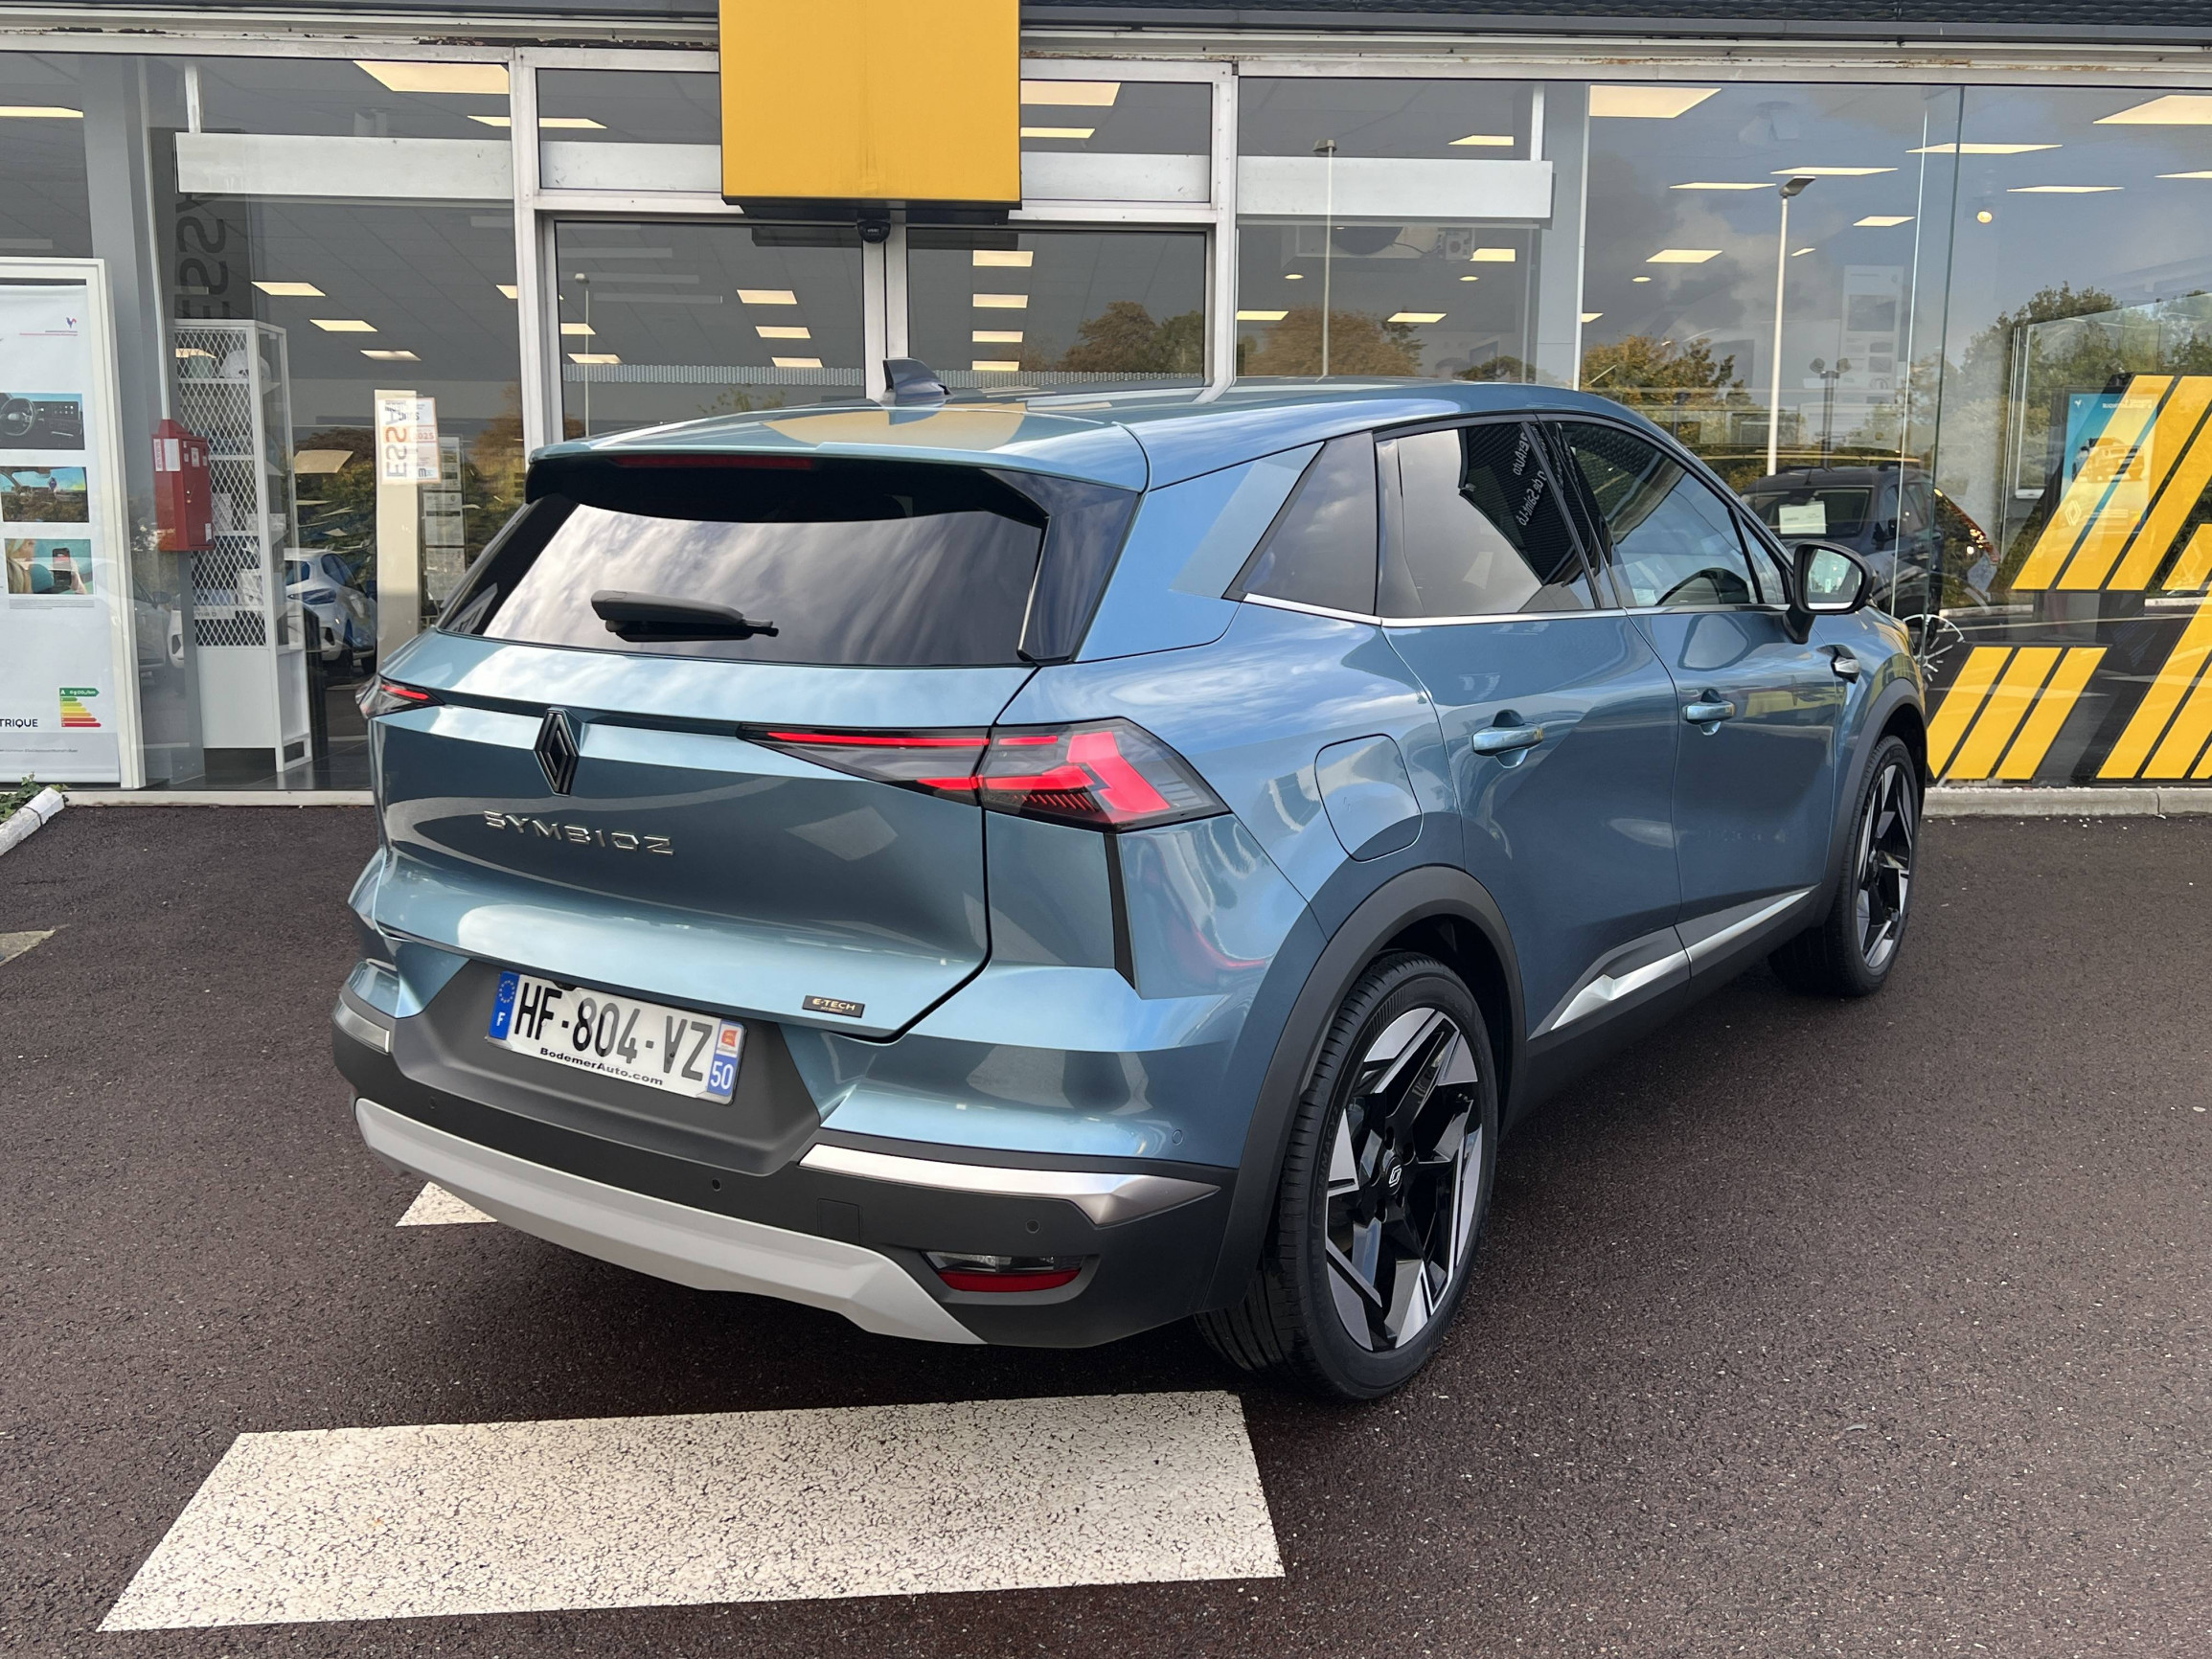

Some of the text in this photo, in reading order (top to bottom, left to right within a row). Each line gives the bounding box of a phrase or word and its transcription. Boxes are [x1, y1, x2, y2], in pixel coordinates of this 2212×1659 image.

[483, 810, 674, 856] SYMBIOZ
[495, 1011, 506, 1027] F
[513, 982, 713, 1082] HF-804-VZ
[539, 1047, 663, 1086] BodemerAuto.com
[710, 1060, 734, 1090] 50
